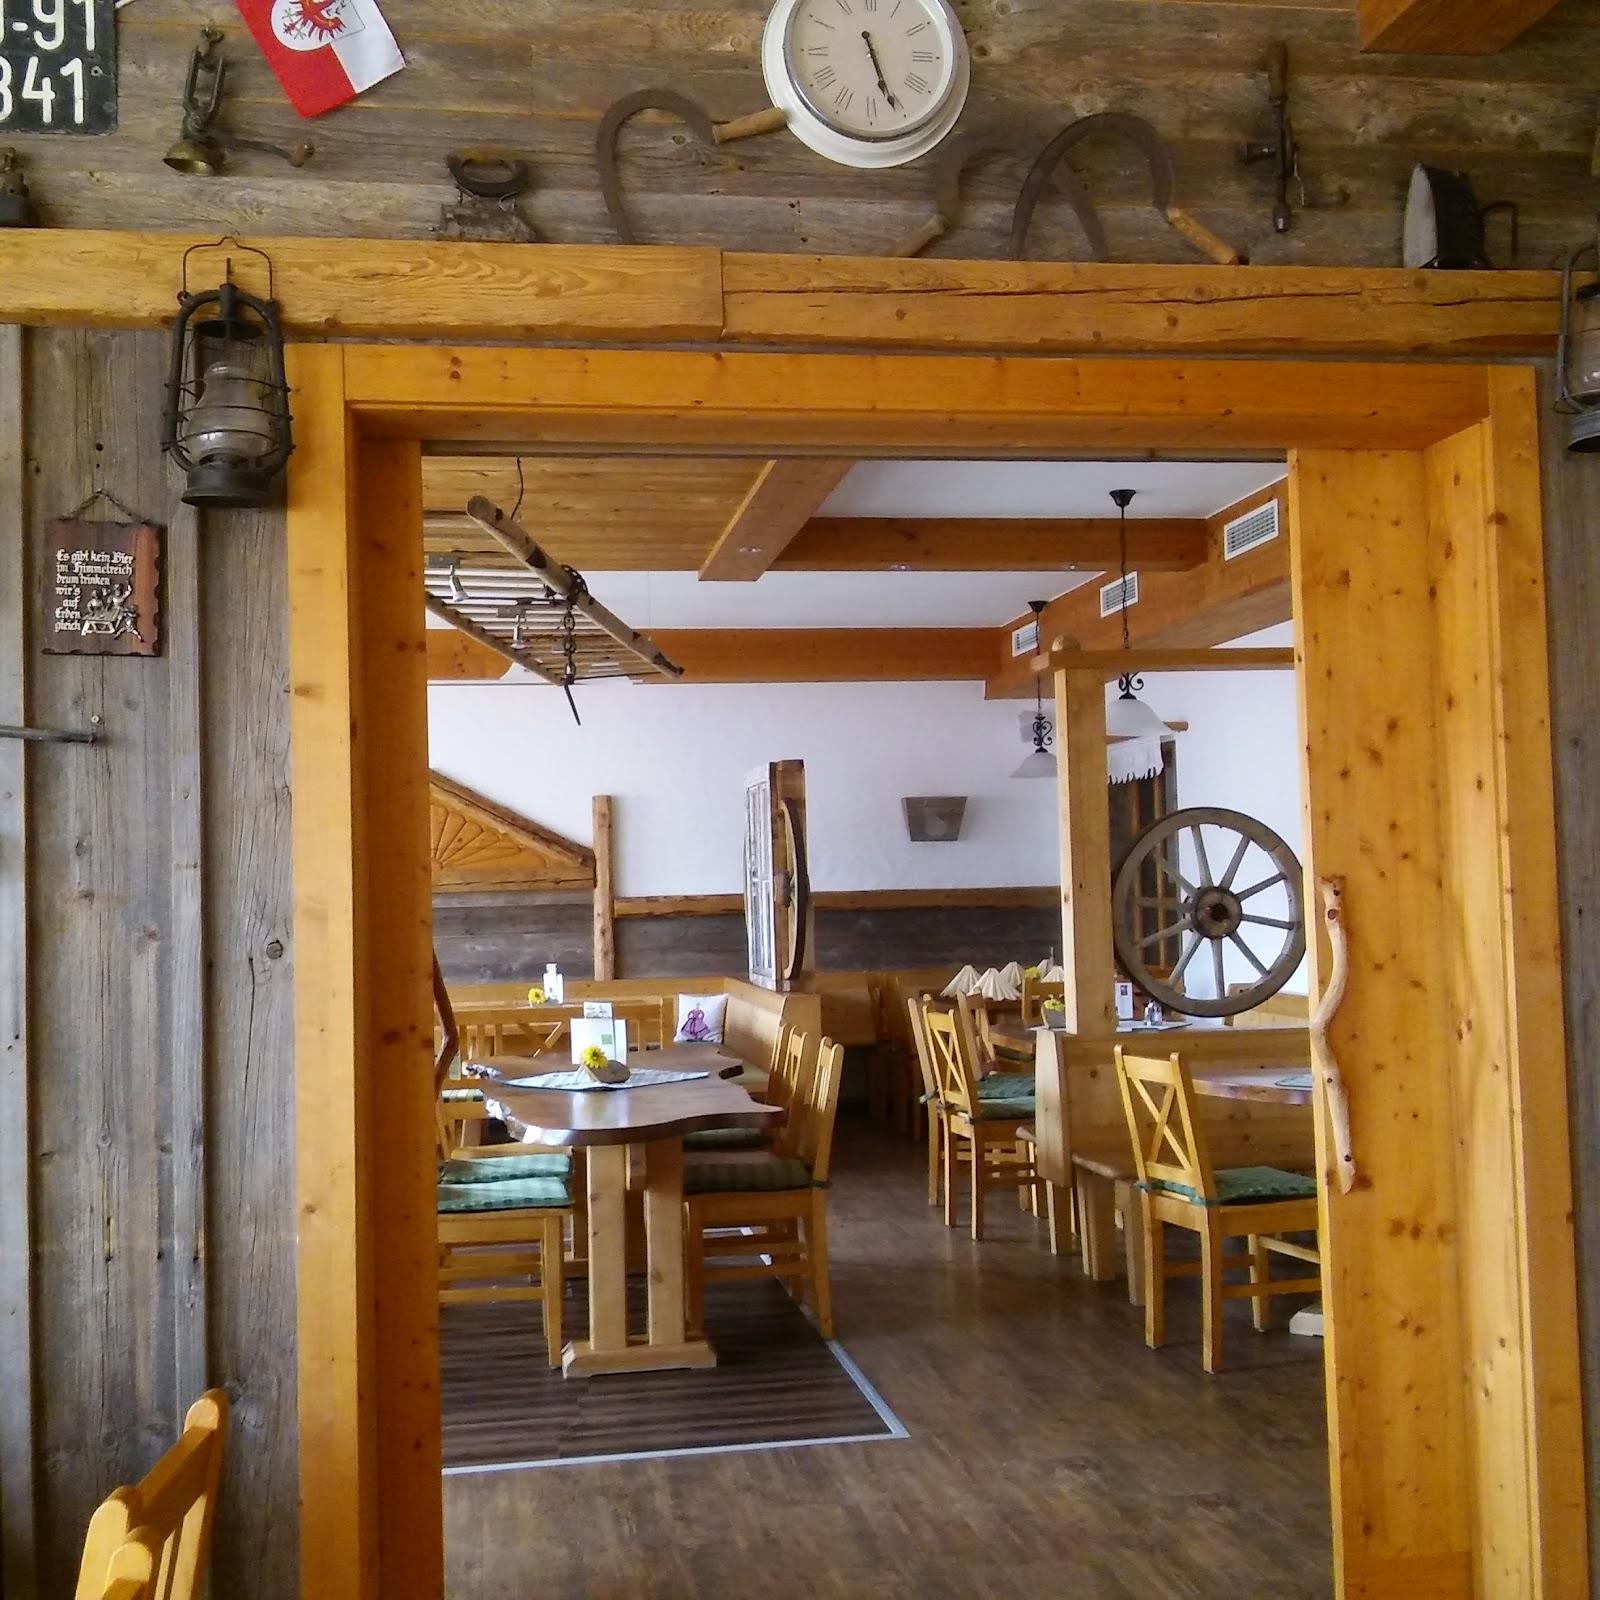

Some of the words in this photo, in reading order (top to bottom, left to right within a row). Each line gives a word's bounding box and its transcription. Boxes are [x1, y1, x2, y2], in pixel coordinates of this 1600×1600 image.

[0, 0, 95, 51] -91
[56, 549, 70, 561] Es
[71, 550, 89, 564] gibt
[90, 550, 110, 563] kein
[111, 551, 134, 564] Bier
[56, 562, 68, 572] im
[73, 561, 133, 577] Himmelreich
[56, 573, 79, 584] drum
[80, 574, 110, 586] trinken
[63, 596, 80, 610] auf
[55, 607, 81, 619] Erden
[55, 619, 81, 633] gleich
